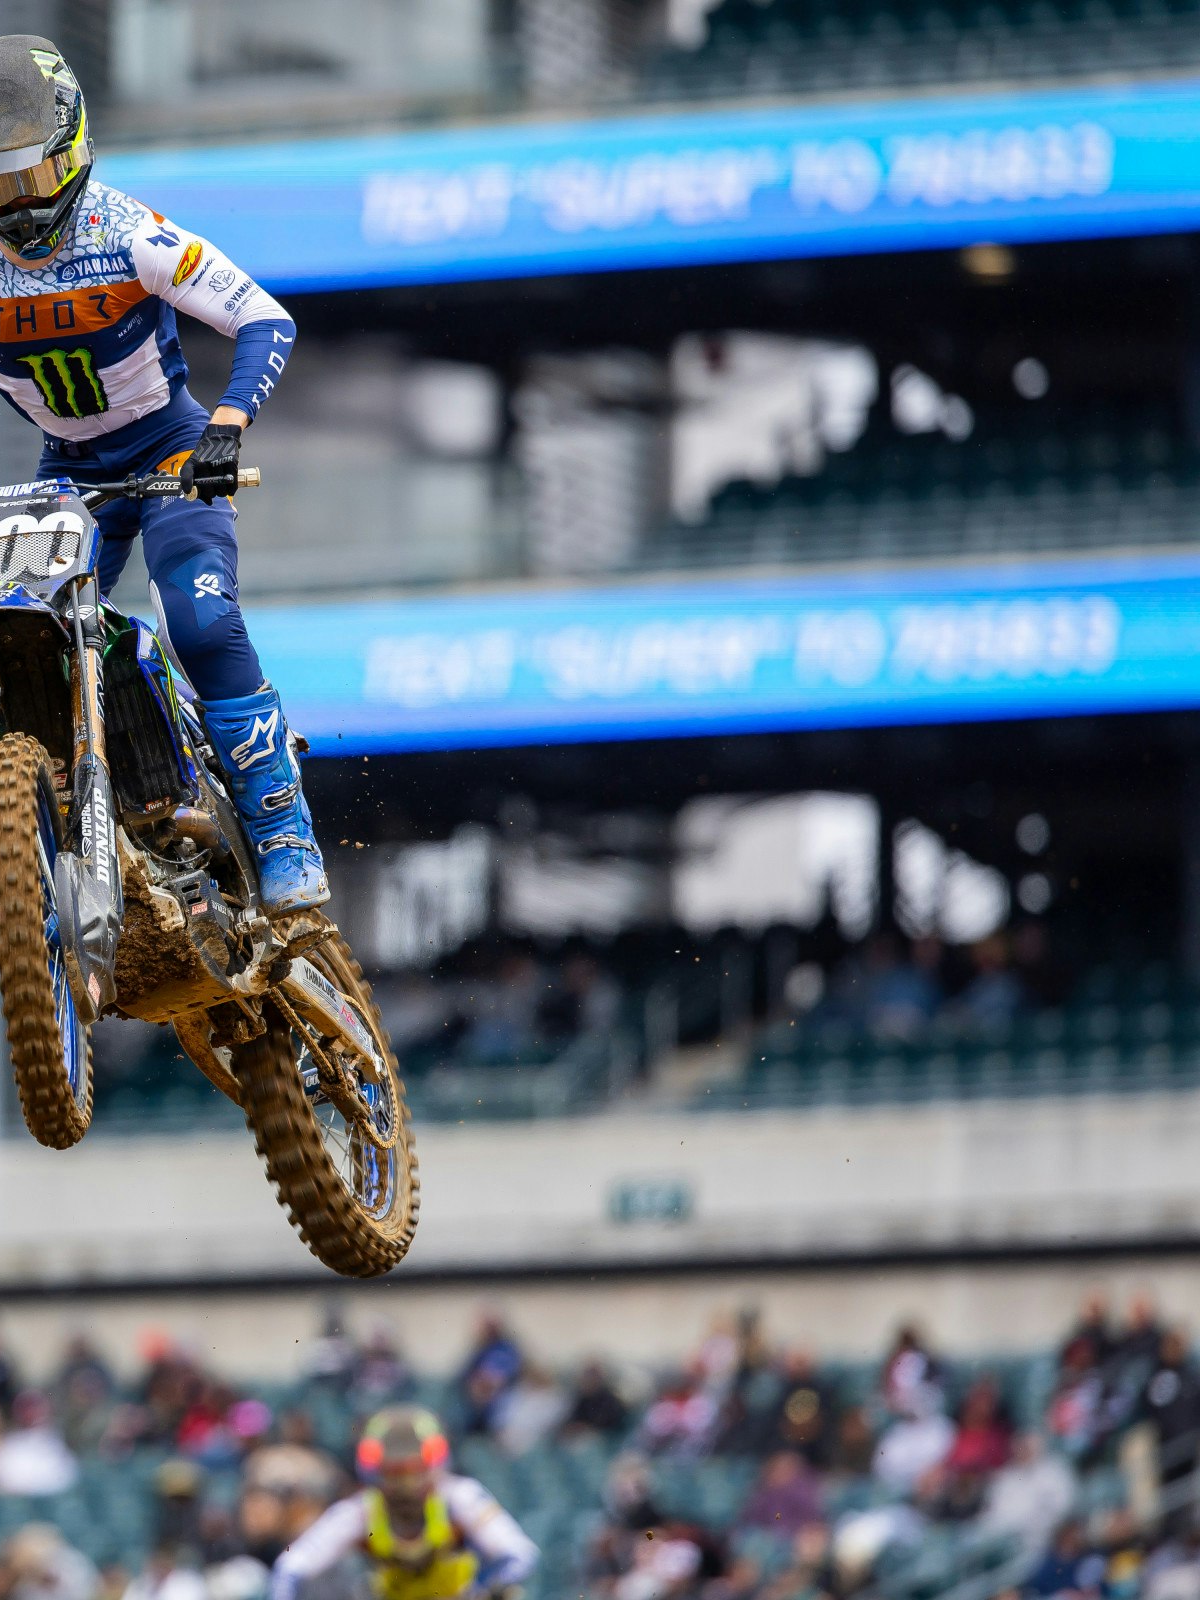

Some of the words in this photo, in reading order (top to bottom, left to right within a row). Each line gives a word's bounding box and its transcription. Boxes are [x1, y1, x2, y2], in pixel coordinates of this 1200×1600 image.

[74, 256, 127, 276] YAMAHA
[211, 456, 234, 468] THOR
[147, 481, 181, 491] ARC
[93, 787, 110, 886] DUNLOP
